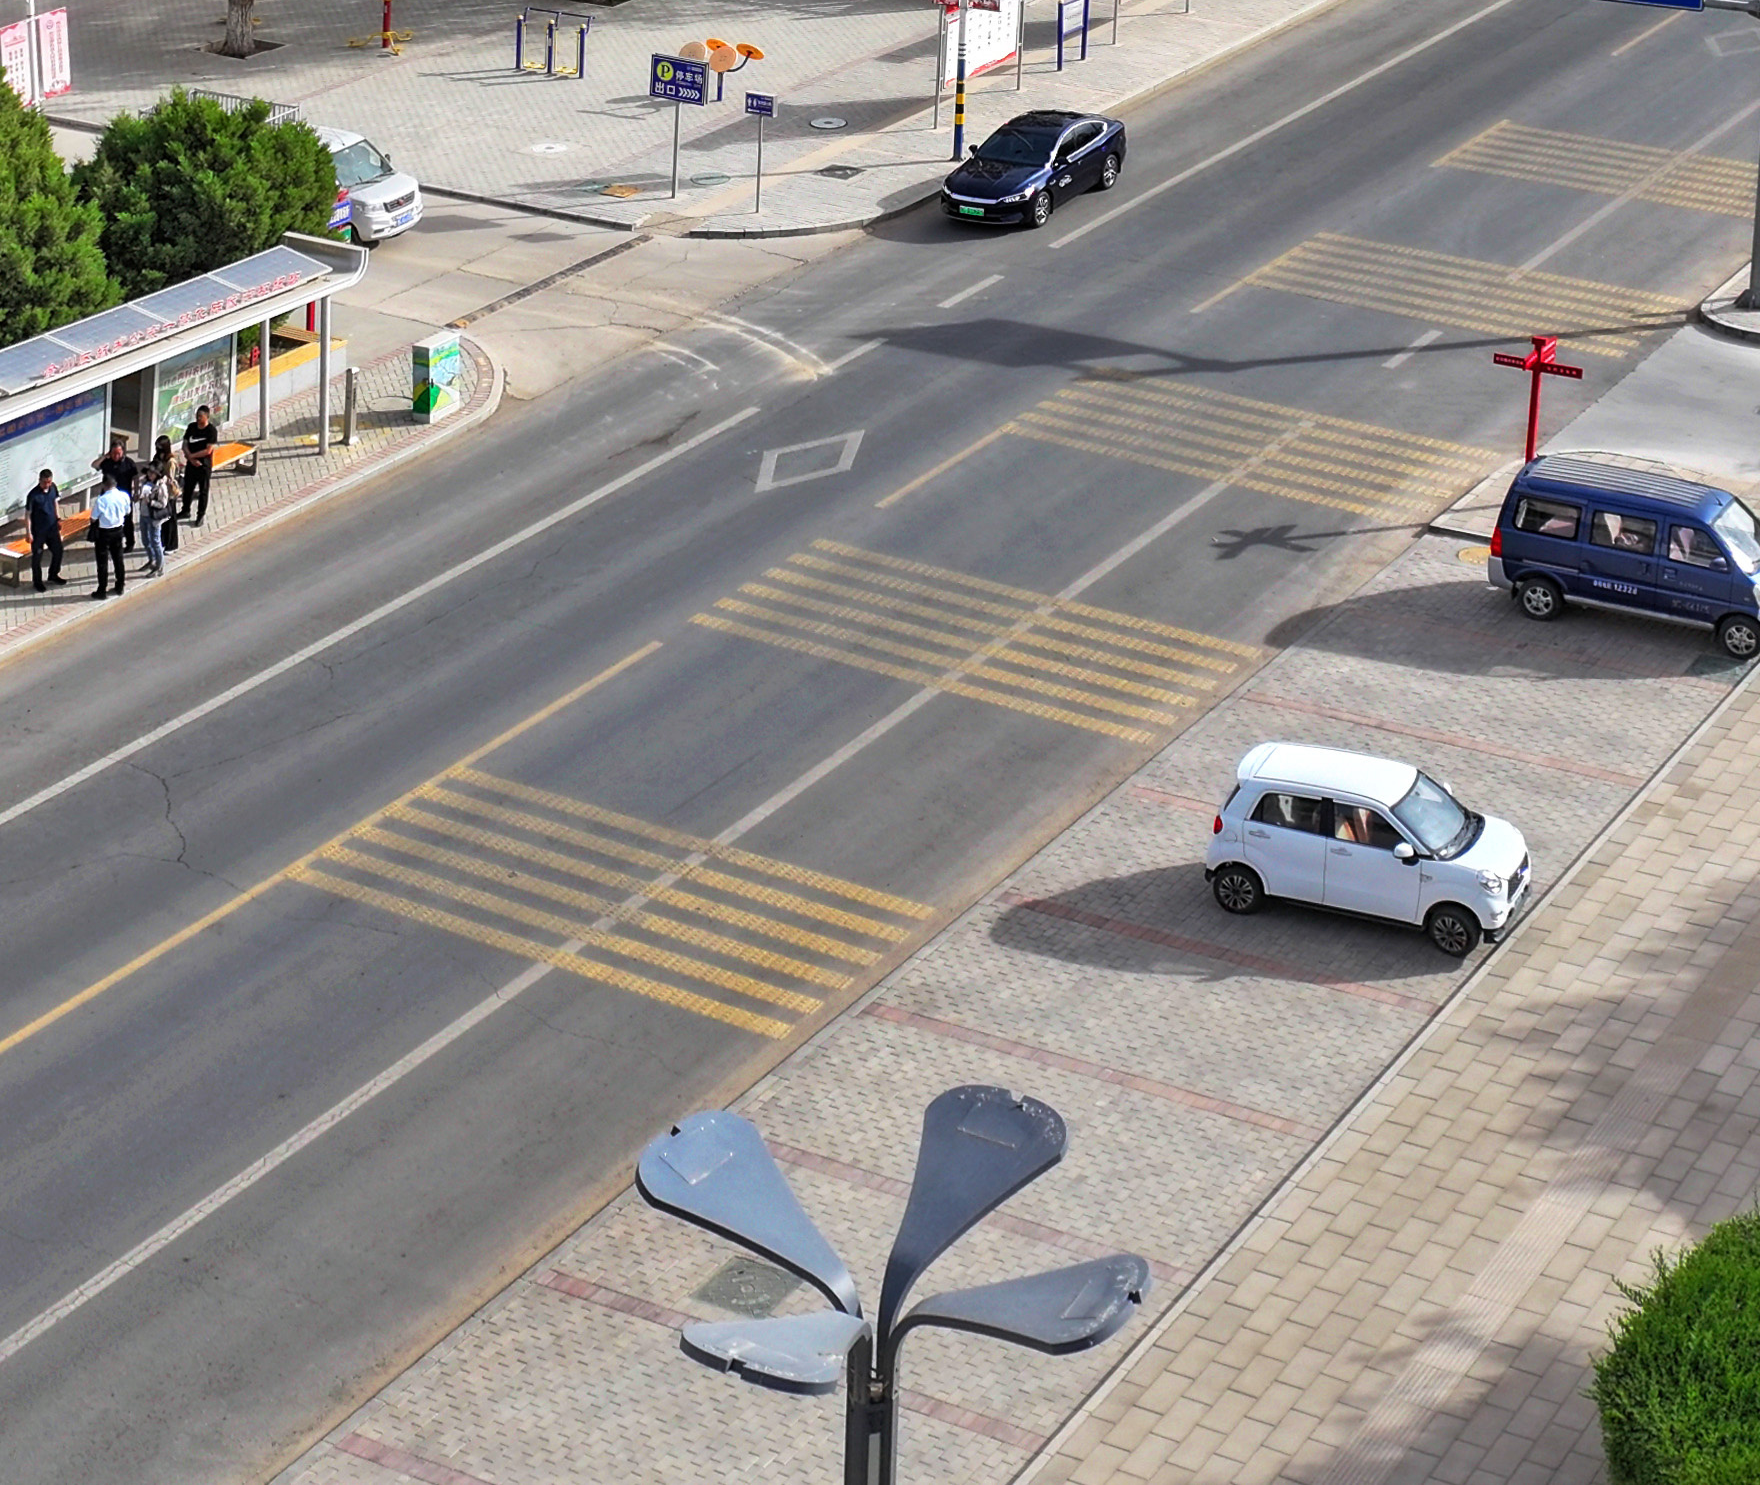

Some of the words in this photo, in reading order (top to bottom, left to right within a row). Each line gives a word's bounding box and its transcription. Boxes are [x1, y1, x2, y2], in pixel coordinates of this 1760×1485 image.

[661, 64, 671, 78] P
[675, 70, 703, 85] 停车场
[654, 81, 676, 95] 出口
